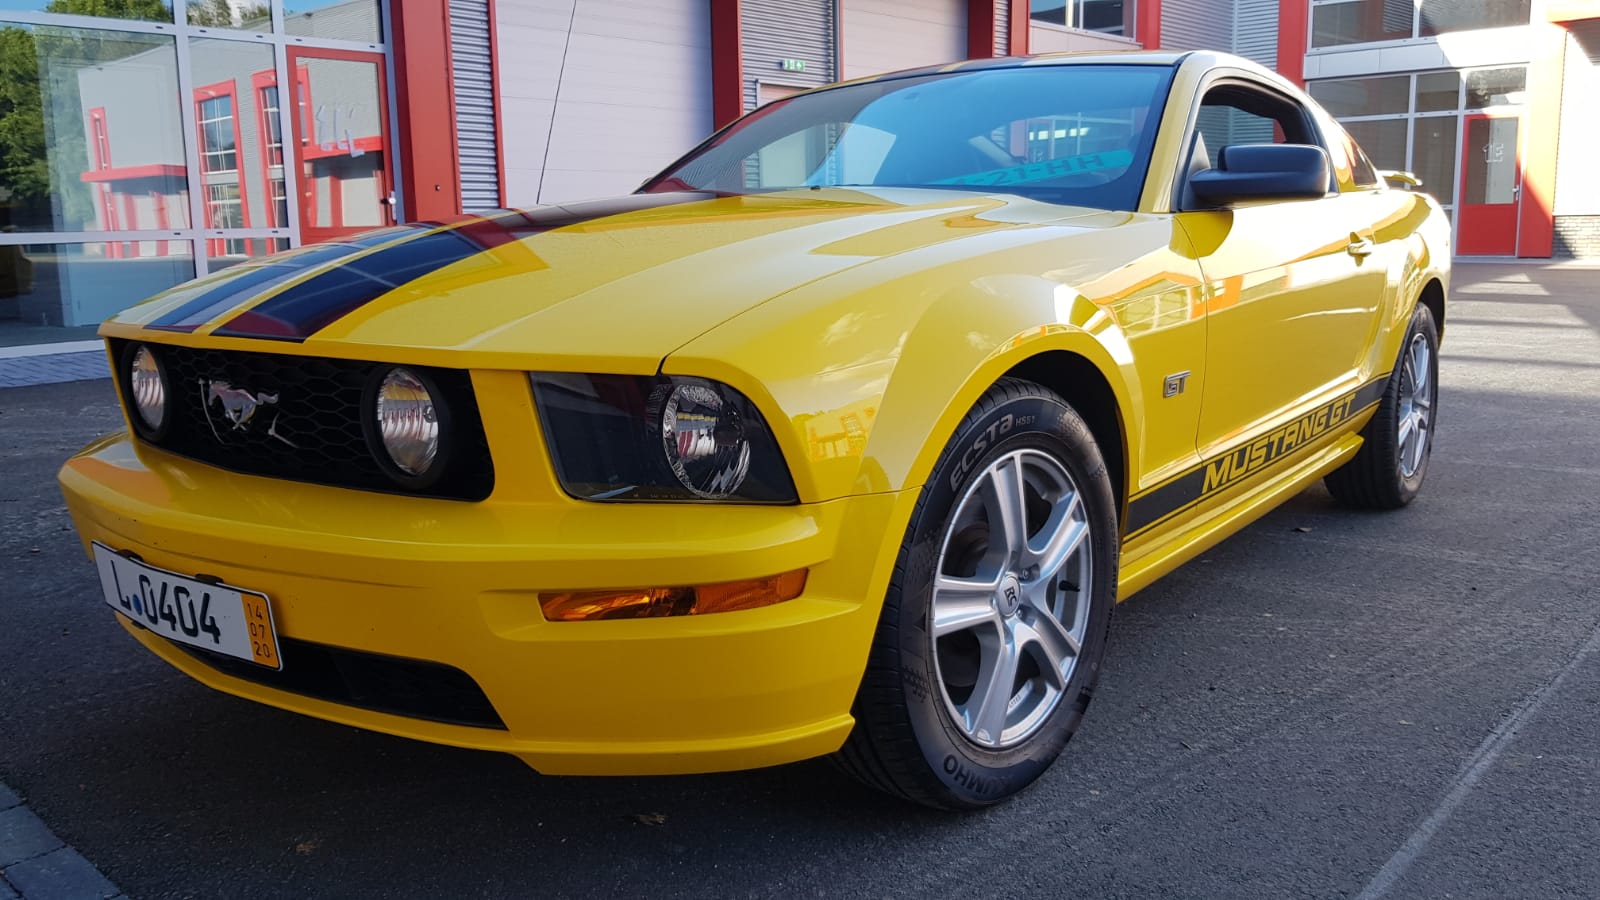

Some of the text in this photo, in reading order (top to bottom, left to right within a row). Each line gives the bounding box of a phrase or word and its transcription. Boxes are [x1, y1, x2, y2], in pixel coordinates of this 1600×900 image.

[1163, 370, 1191, 398] GT
[1201, 393, 1357, 494] MUSTANG GT
[138, 574, 221, 644] 0404
[247, 602, 263, 620] 14
[249, 622, 266, 639] 07
[253, 640, 271, 658] 20
[943, 754, 1004, 794] UMHO
